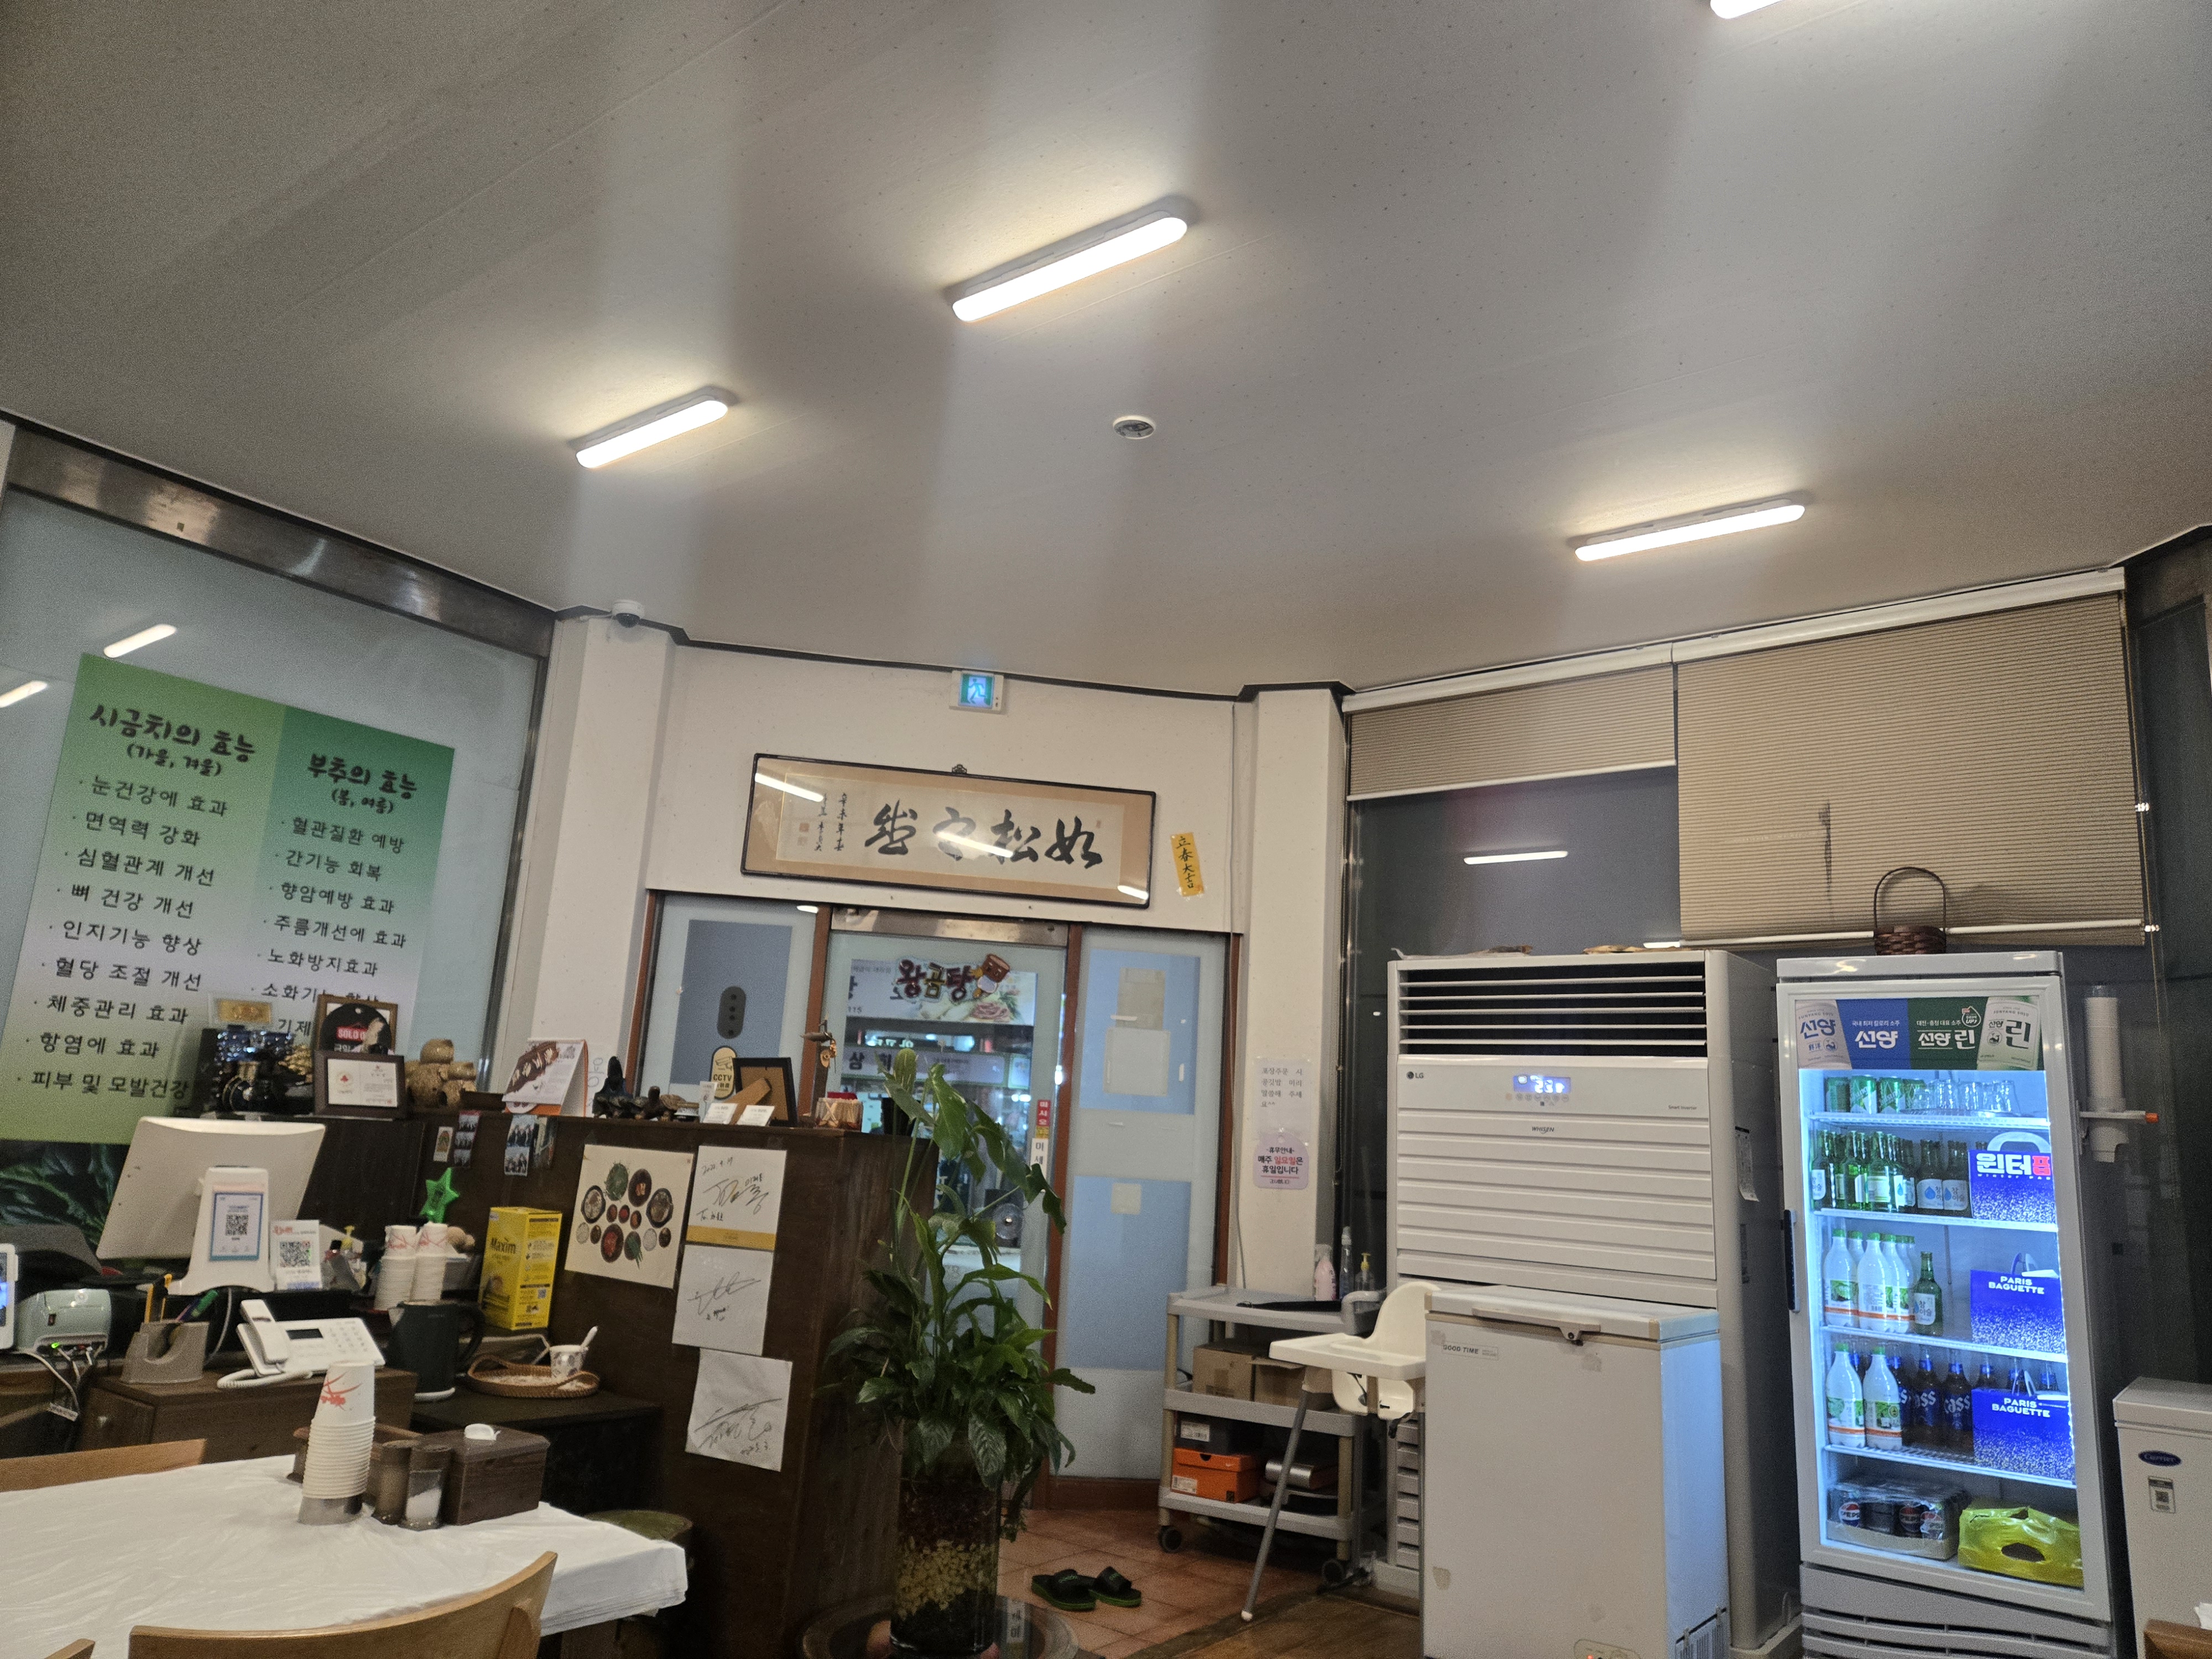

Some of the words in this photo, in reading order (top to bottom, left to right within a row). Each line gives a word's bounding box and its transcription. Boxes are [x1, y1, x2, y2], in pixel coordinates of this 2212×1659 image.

[90, 704, 201, 746] 시금치의
[210, 730, 255, 763] 효능
[127, 743, 174, 768] (가을,
[184, 755, 222, 776] 겨울)
[308, 754, 371, 785] 부추의
[379, 770, 417, 800] 효능
[92, 775, 178, 808] 눈건강에
[187, 795, 228, 817] 효과
[361, 797, 393, 814] 여름)
[86, 811, 149, 839] 면역력
[160, 825, 200, 846] 강화
[293, 817, 364, 846] 혈관질환
[372, 834, 404, 854] 예방
[77, 848, 165, 877] 심혈관계
[175, 863, 214, 886] 개선
[286, 850, 340, 874] 간기능
[347, 860, 382, 882] 회복
[1176, 836, 1196, 889] 立春大吉
[71, 884, 90, 901] 뼈
[102, 888, 143, 911] 건강
[153, 896, 194, 919] 개선
[361, 895, 394, 915] 효과
[63, 920, 150, 950] 인지기능
[162, 933, 202, 956] 향상
[274, 915, 365, 943] 주름개선에
[373, 930, 406, 948] 효과
[56, 957, 99, 980] 혈당
[108, 964, 150, 987] 조절
[161, 971, 201, 992] 개선
[268, 948, 378, 978] 노화방지효과
[261, 983, 326, 1004] 소화기
[896, 959, 975, 1002] 왕곰탕
[46, 995, 137, 1019] 체중관리
[146, 1005, 189, 1025] 효과
[1799, 1018, 1836, 1040] 선양
[1854, 1030, 1899, 1049] 선양
[1918, 1032, 1952, 1046] 선양
[1954, 1030, 1976, 1050] 린
[2006, 1019, 2031, 1049] 린
[116, 1038, 159, 1059] 효과
[31, 1071, 72, 1091] 피부
[82, 1073, 101, 1095] 및
[108, 1076, 189, 1100] 모발건강
[712, 1073, 733, 1082] CCTV
[1289, 1079, 1302, 1087] 미리
[1258, 1155, 1272, 1164] 매주
[1274, 1156, 1303, 1165] 일요일은
[1261, 1165, 1299, 1175] 휴일입니다
[491, 1237, 517, 1255] Maxim
[1988, 1281, 2045, 1295] BAGUETTE
[2000, 1275, 2033, 1286] PARIS
[1991, 1403, 2051, 1418] BAGUETTE
[2004, 1397, 2038, 1409] PARIS
